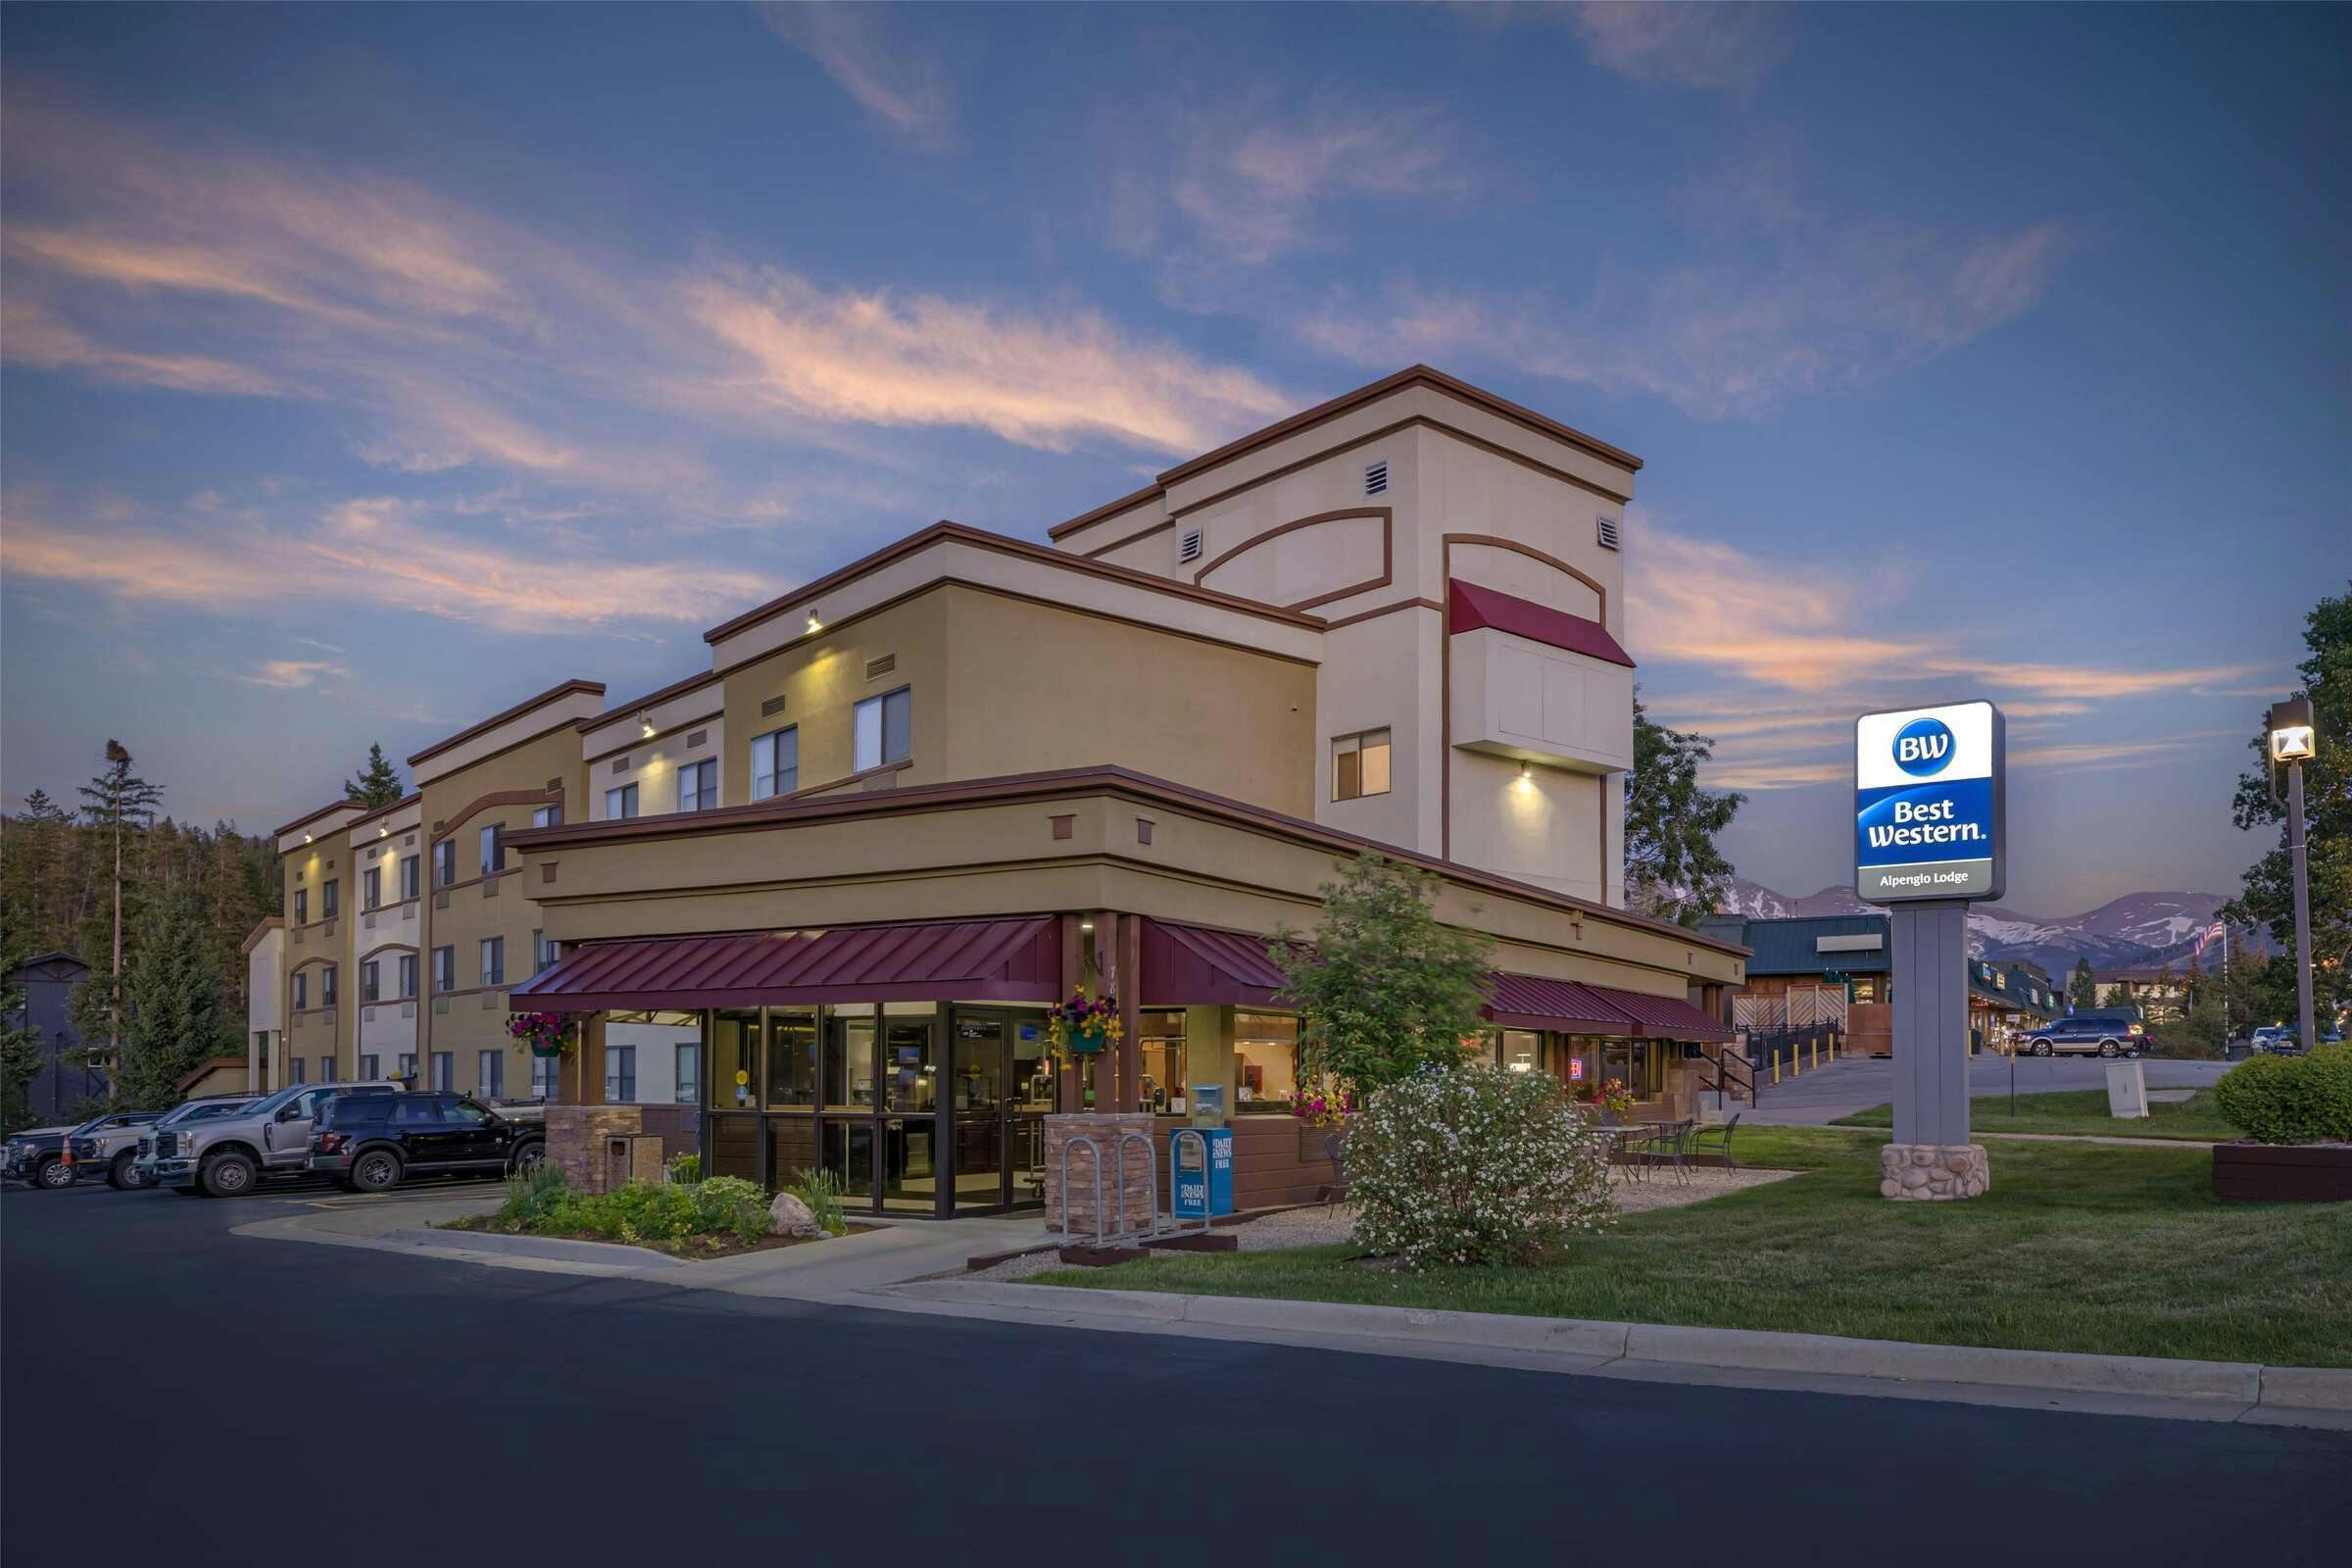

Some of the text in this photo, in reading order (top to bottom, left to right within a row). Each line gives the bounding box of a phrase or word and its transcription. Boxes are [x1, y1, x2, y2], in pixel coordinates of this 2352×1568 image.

[1899, 733, 1948, 761] BW
[1894, 799, 1954, 823] Best
[1880, 870, 1969, 888] Alpenglo Lodge
[1215, 1138, 1232, 1148] DAILY
[1215, 1148, 1232, 1158] NEWS
[1215, 1158, 1229, 1168] FREE
